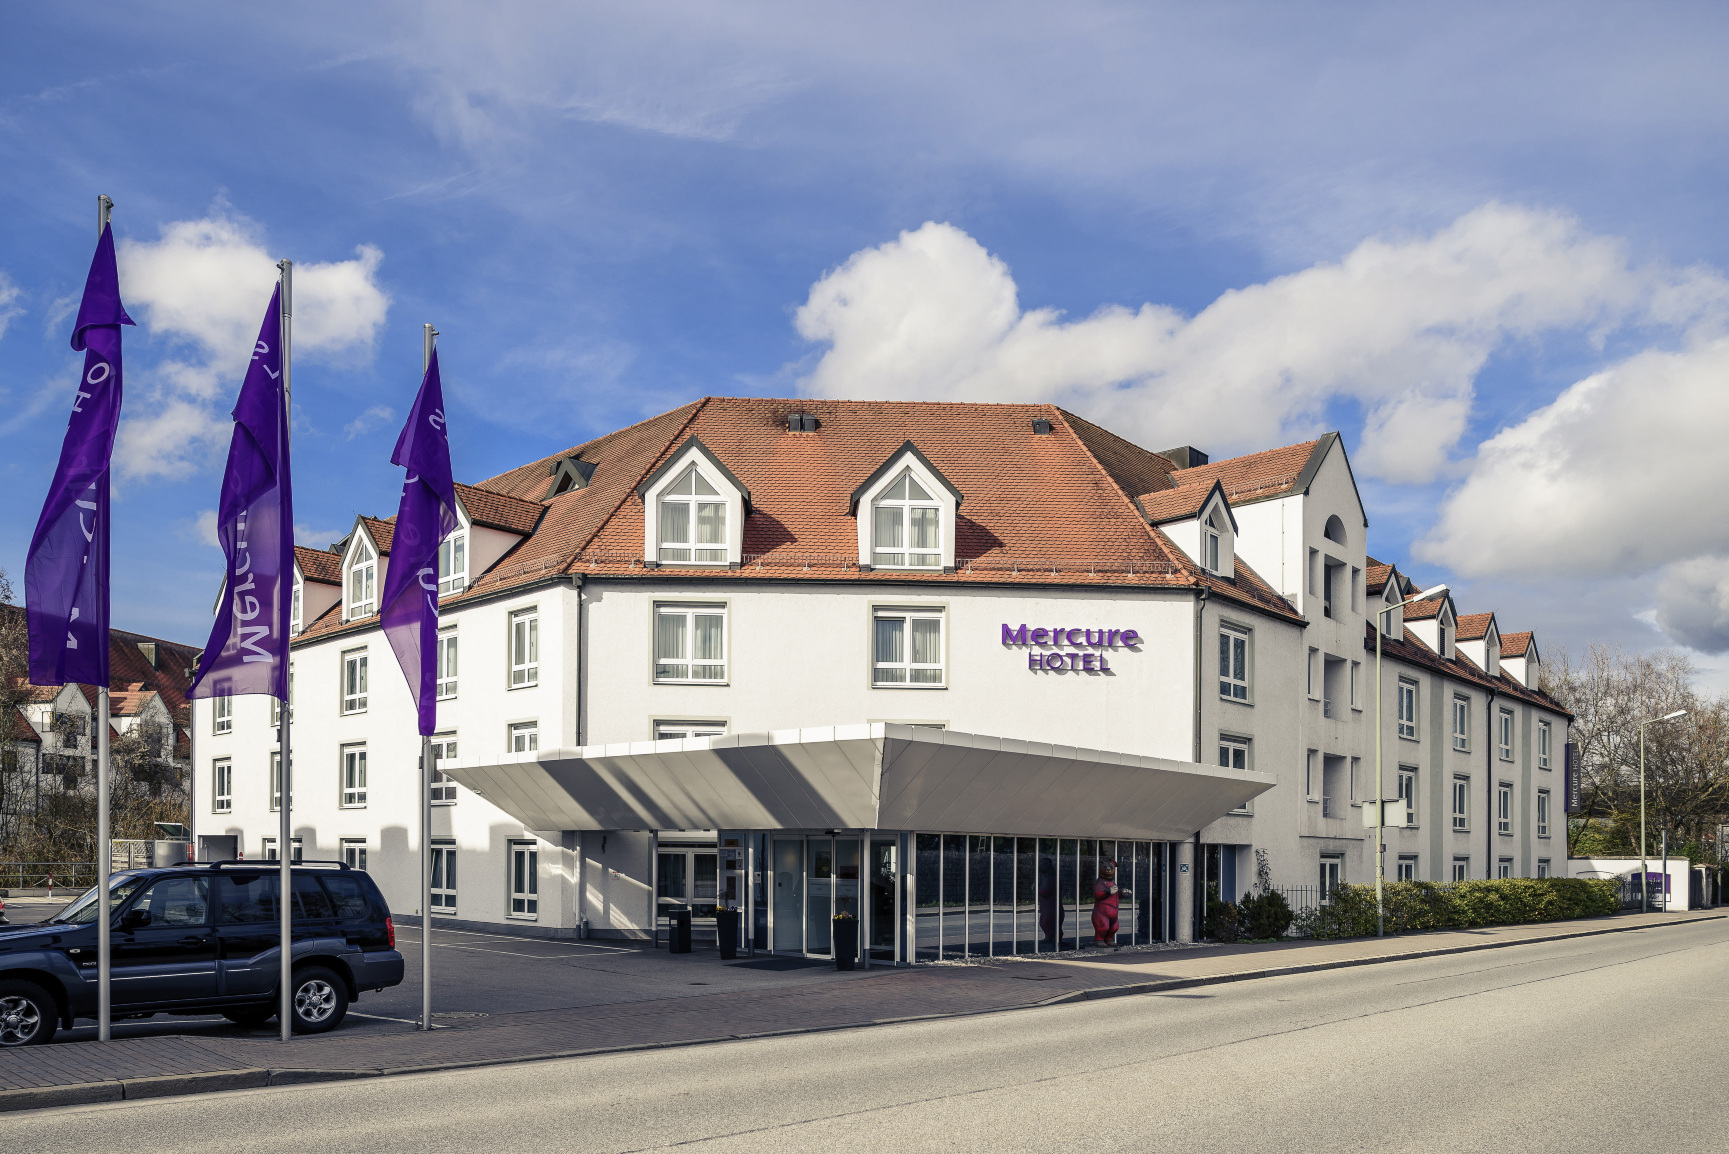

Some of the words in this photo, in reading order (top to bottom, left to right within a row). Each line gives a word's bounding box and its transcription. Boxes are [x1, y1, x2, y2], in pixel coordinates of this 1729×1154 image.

[1001, 623, 1139, 647] Mercure
[1028, 652, 1111, 671] HOTEL
[1571, 771, 1579, 807] Mercure
